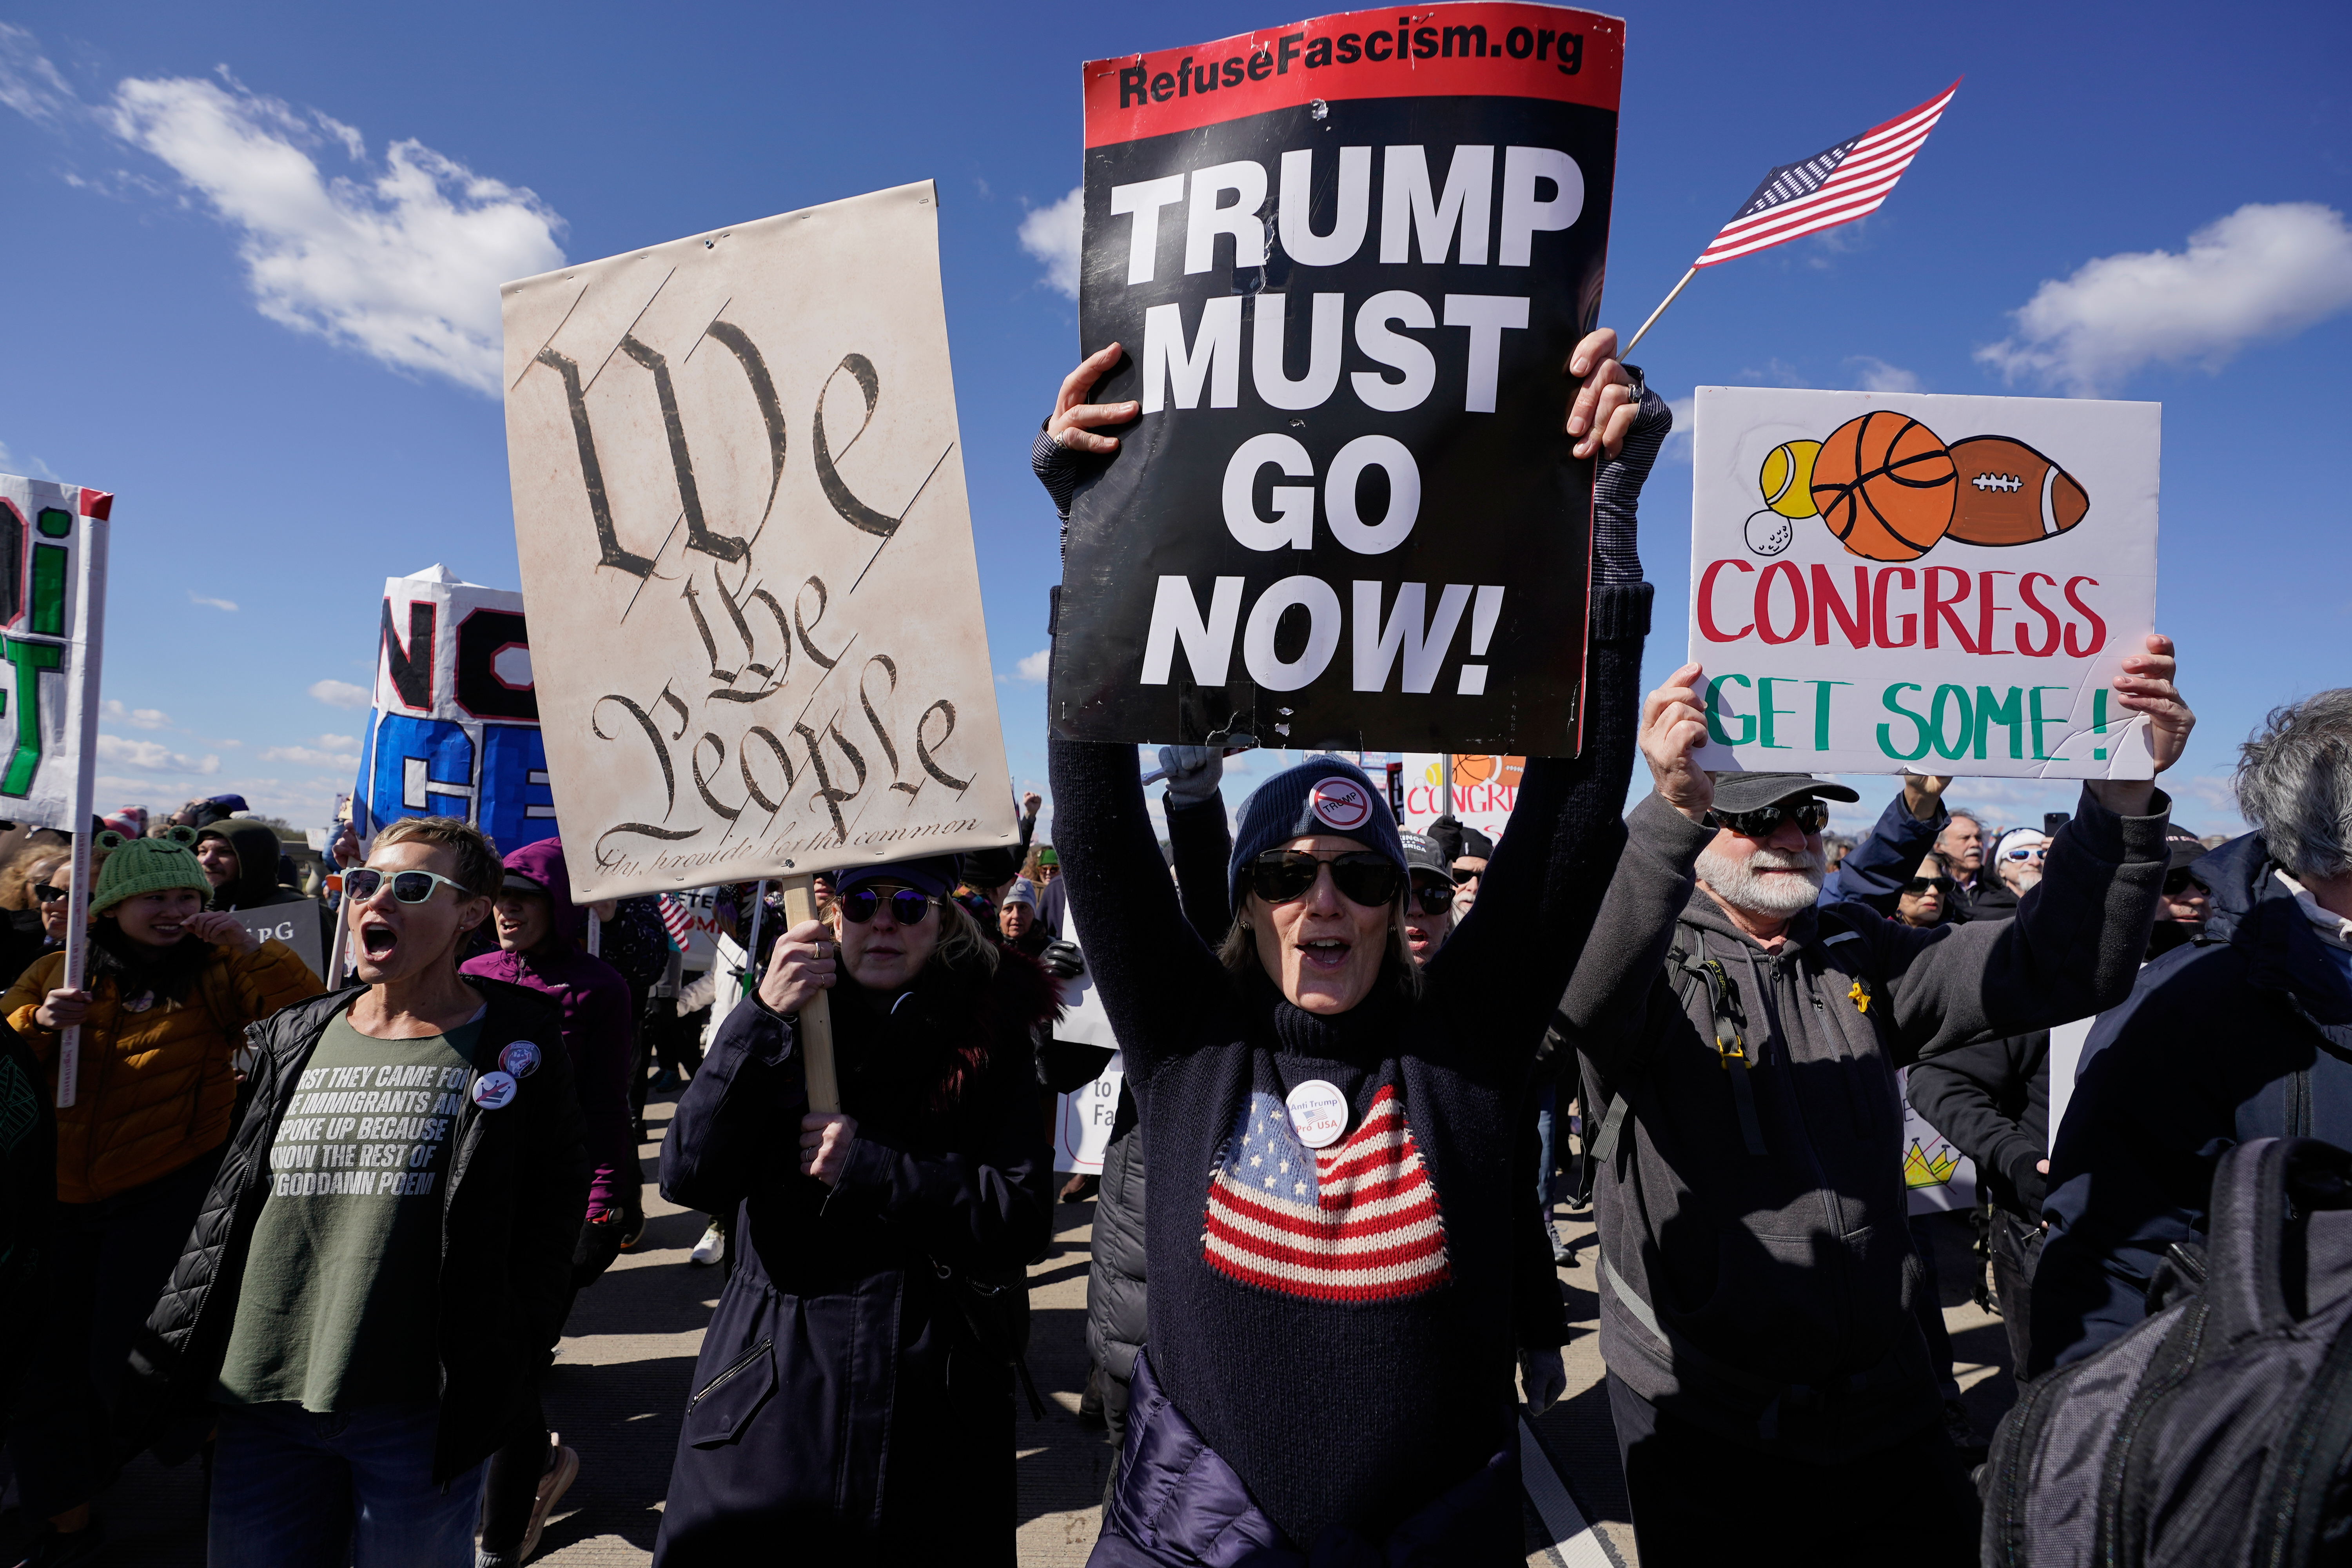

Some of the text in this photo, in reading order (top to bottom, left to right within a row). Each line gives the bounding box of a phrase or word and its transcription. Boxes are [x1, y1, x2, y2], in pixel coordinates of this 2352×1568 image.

[1119, 16, 1583, 109] RefuseFascism.org
[1111, 145, 1584, 286] TRUMP
[1142, 289, 1531, 413] MUST
[512, 269, 953, 604] We
[1221, 433, 1421, 555] GO
[1140, 574, 1506, 696] NOW!
[1697, 558, 2107, 658] CONGRESS
[376, 595, 540, 722] NO
[1704, 674, 1854, 752] GET
[592, 654, 977, 869] People
[1323, 792, 1357, 813] TRUMP
[647, 837, 757, 875] provide
[762, 822, 804, 858] for
[854, 817, 983, 846] common
[1402, 843, 1426, 852] ERICA
[287, 1091, 462, 1116] HE IMMIGRANTS AN
[296, 1067, 330, 1091] RST
[330, 1066, 377, 1089] THEY
[375, 1065, 440, 1087] CAME
[1094, 1079, 1111, 1097] to
[1290, 1099, 1338, 1111] Anti Trump
[275, 1117, 448, 1143] SPOKE UP BECAUSE
[1318, 1120, 1338, 1129] USA
[270, 1144, 437, 1169] KNOW THE REST OF
[276, 1171, 379, 1197] GODDAMN
[377, 1172, 436, 1195] POEM
